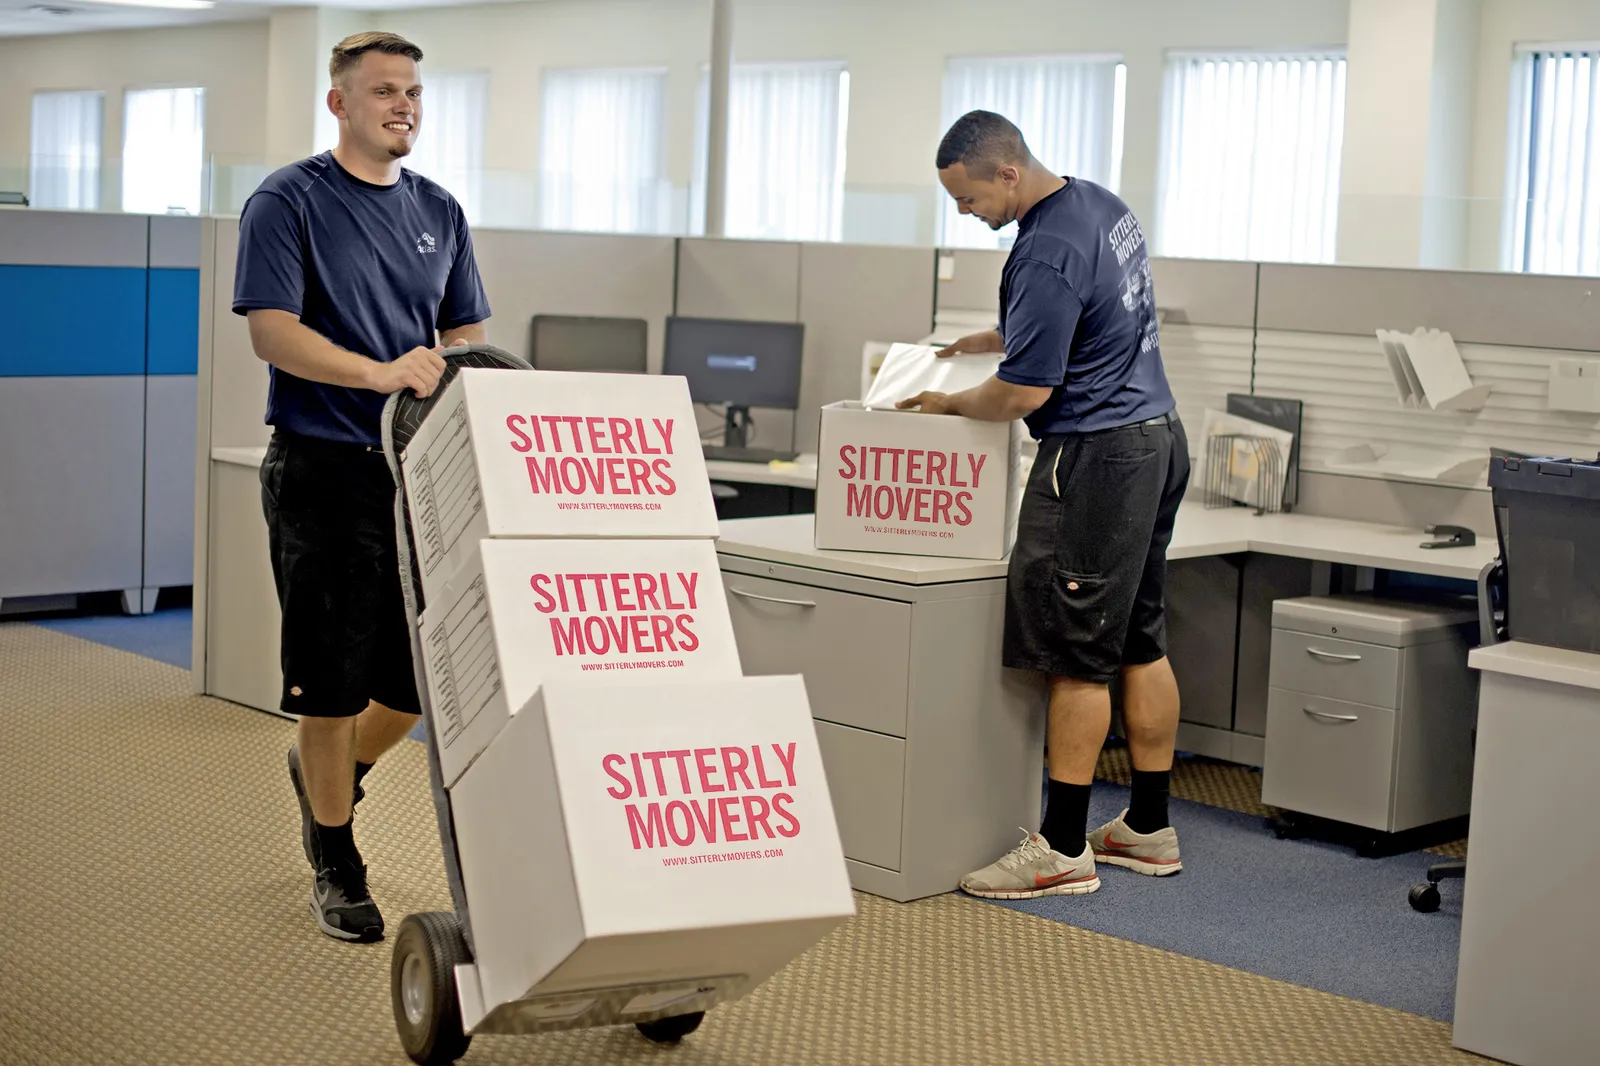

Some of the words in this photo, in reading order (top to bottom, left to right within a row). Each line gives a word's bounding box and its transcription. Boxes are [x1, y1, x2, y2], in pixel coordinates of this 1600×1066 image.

[1109, 211, 1137, 251] SITTERL
[1115, 224, 1144, 267] MOVERS
[506, 413, 675, 455] SITTERLY
[525, 456, 676, 496] MOVERS
[838, 445, 987, 489] SITTERLY
[558, 502, 662, 511] WWW.SITTERLYMOVERS.COM
[847, 483, 973, 526] MOVERS
[530, 572, 699, 614] SITTERLY
[549, 614, 700, 656] MOVERS
[581, 659, 685, 671] WWW.SITTERLYMOVERS.COM
[602, 742, 797, 800] SITTERLY
[624, 792, 801, 850] MOVERS
[662, 848, 785, 867] WWW.SITTERLYMOVERS.COM
